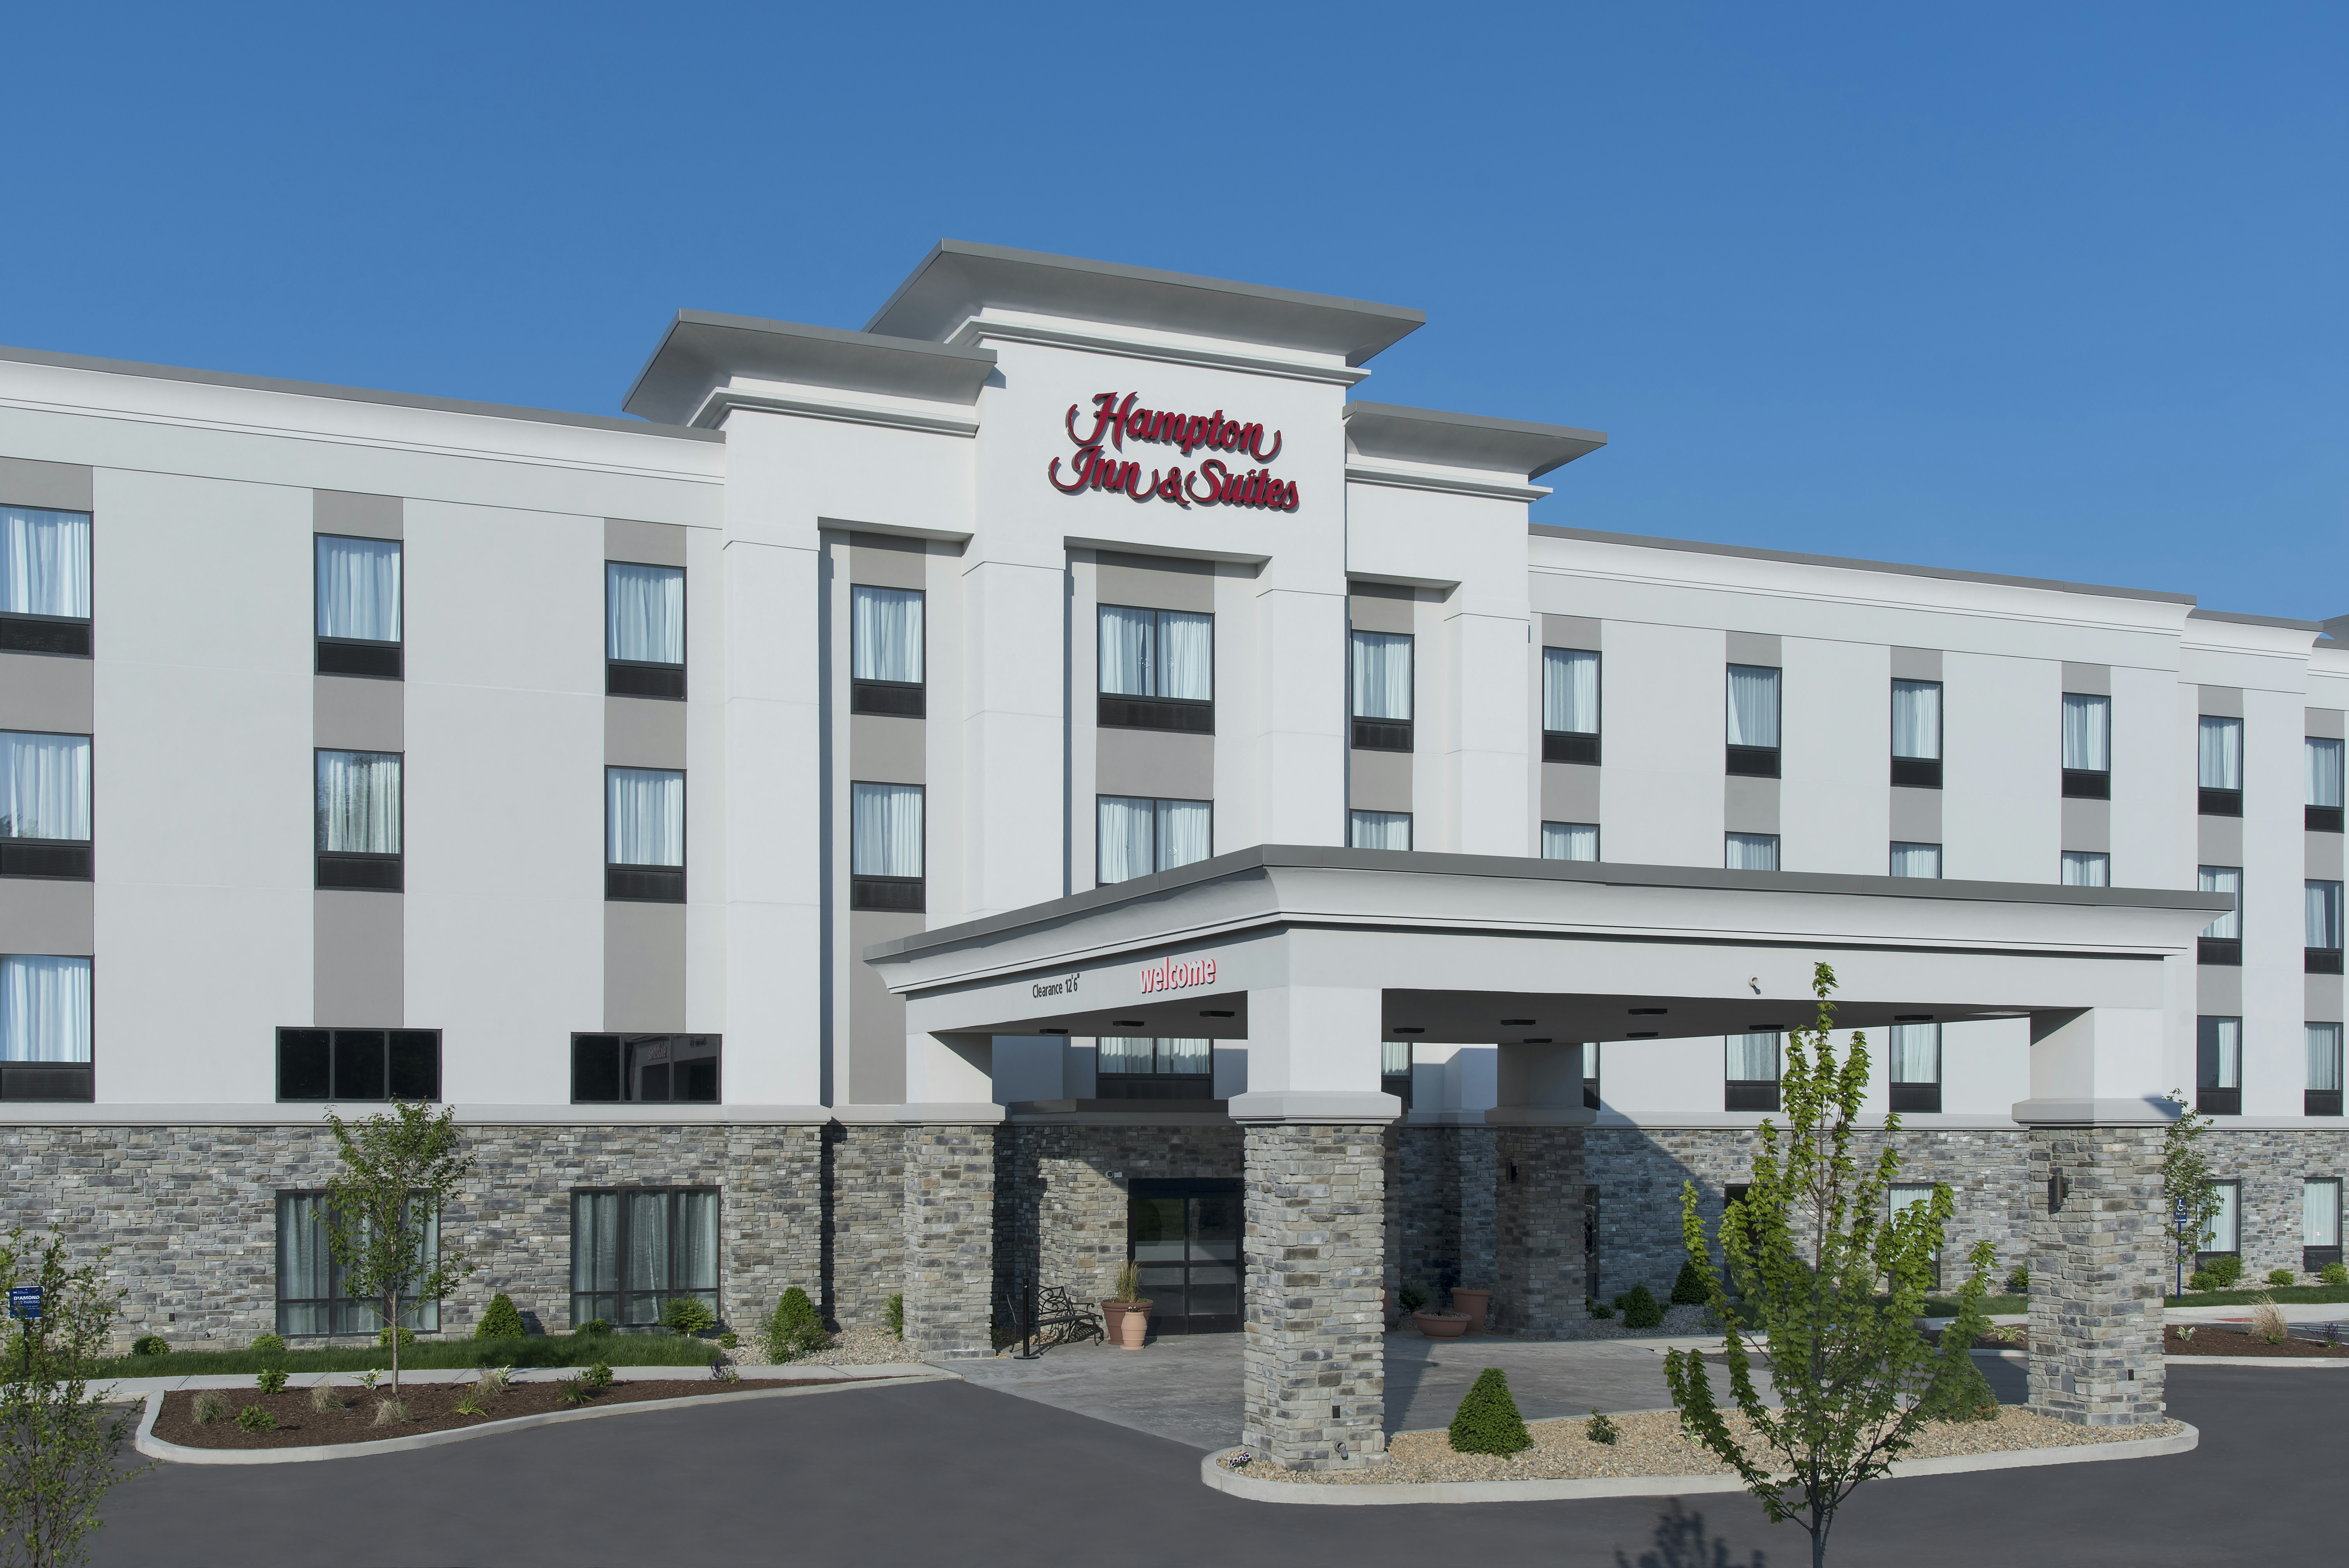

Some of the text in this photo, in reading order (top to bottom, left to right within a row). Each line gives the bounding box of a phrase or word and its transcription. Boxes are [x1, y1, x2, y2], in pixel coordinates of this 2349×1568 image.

[1066, 392, 1281, 461] Hampton
[1048, 445, 1299, 510] Inn & Suites
[1033, 984, 1063, 998] Clearance
[1139, 957, 1216, 994] welcome
